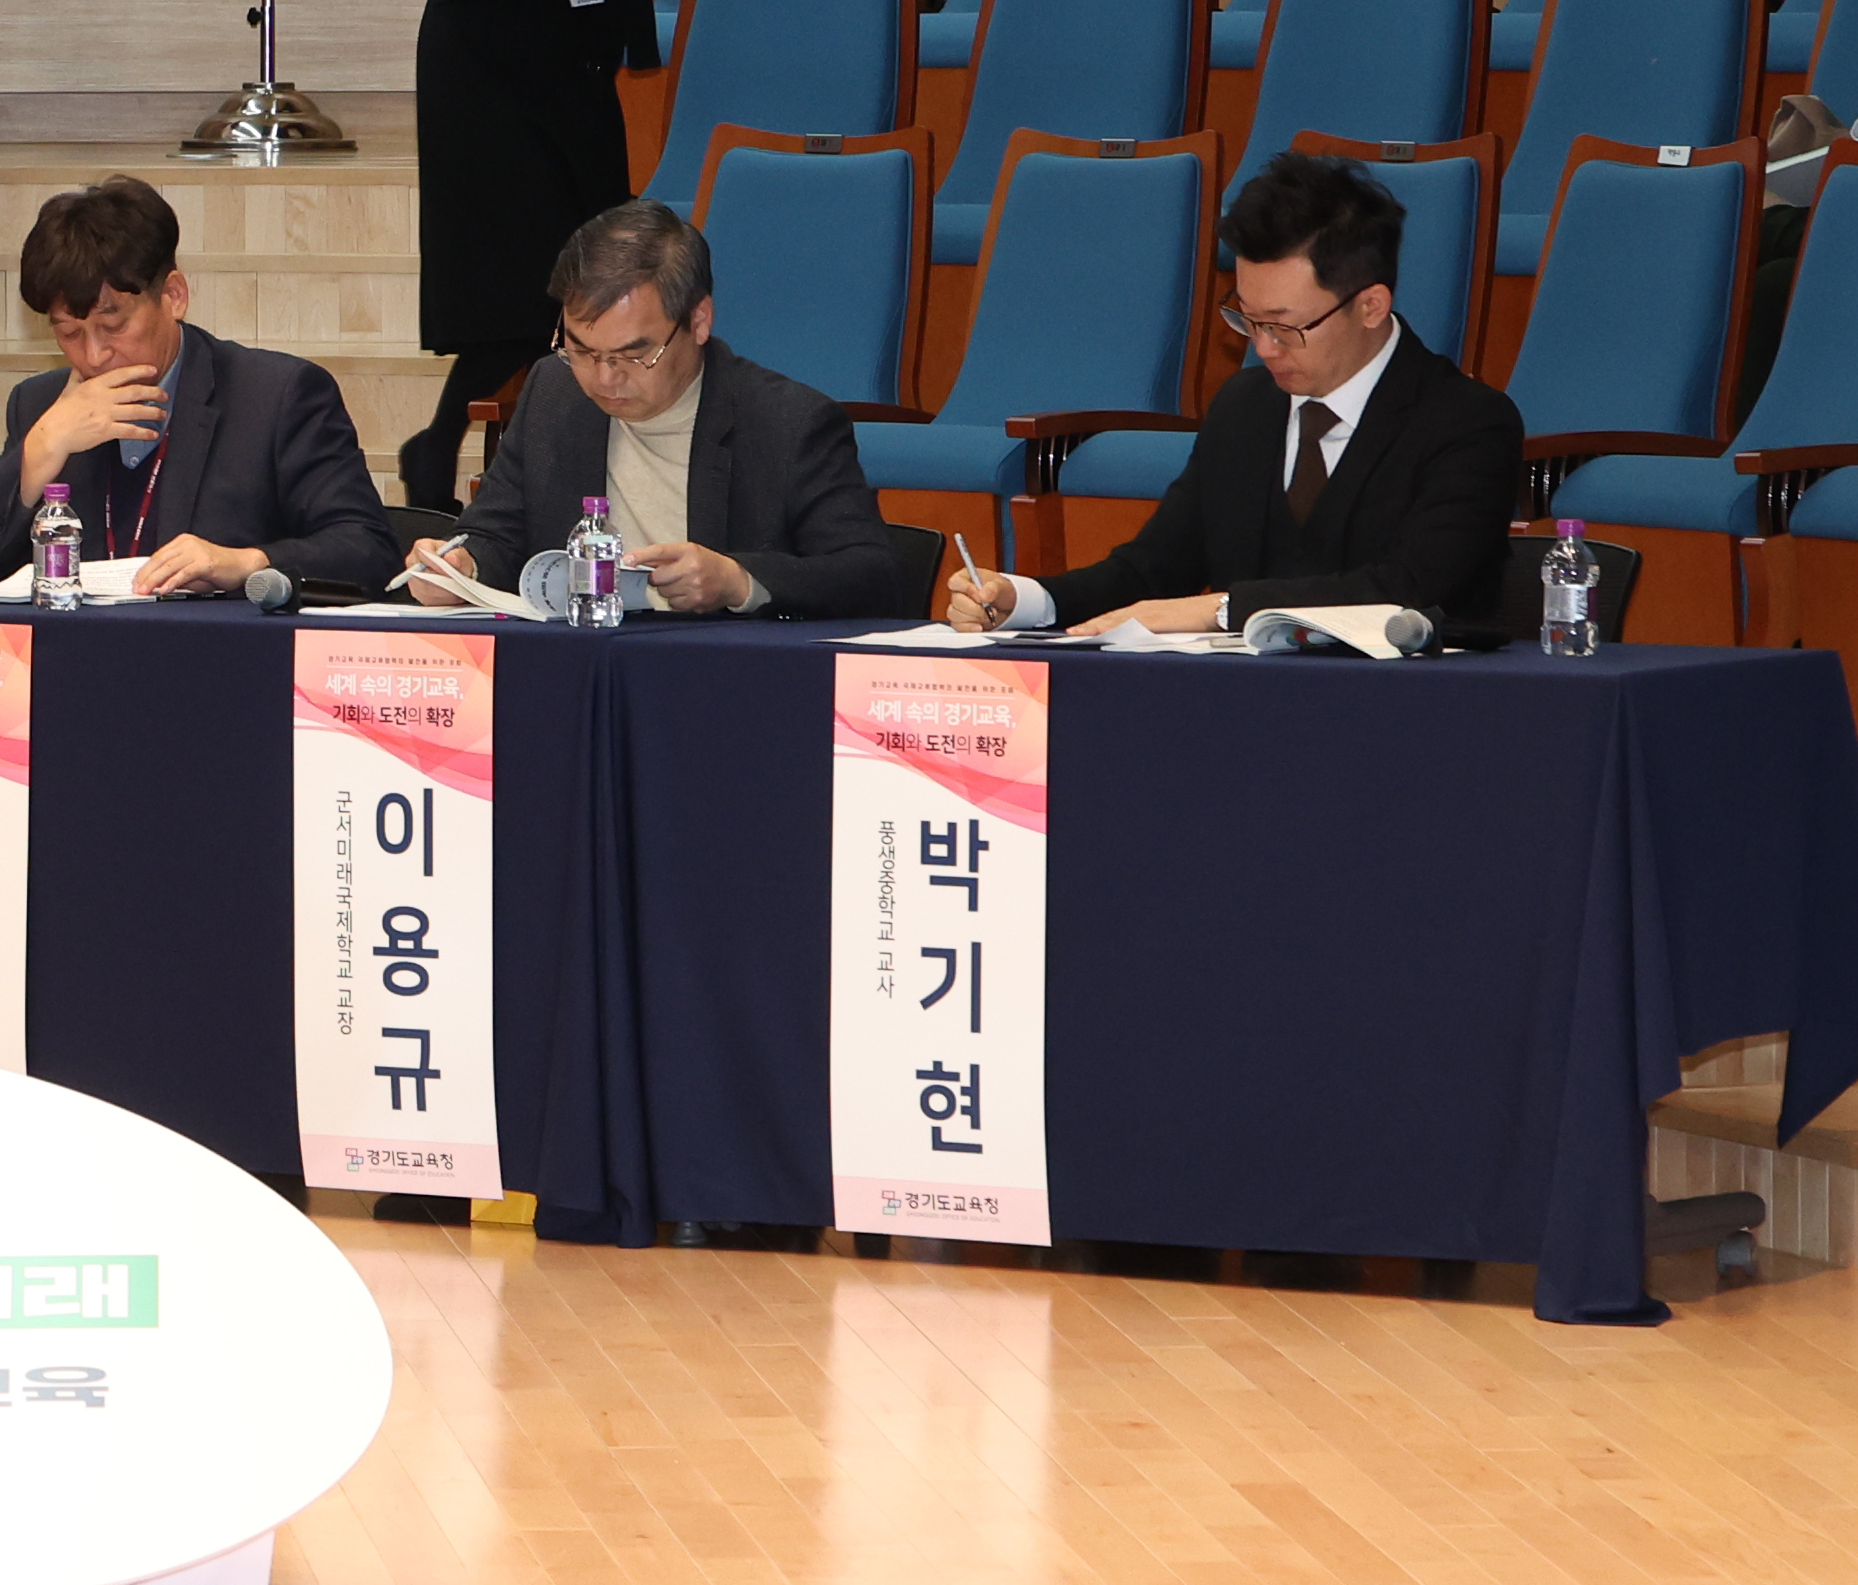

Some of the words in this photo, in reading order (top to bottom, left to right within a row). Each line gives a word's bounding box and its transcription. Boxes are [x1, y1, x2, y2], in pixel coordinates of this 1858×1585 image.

[324, 673, 357, 696] 세계
[360, 674, 392, 697] 속의
[396, 676, 464, 700] 경기교육,
[332, 704, 375, 725] 기회와
[378, 705, 422, 726] 도전의
[425, 706, 456, 728] 확장
[866, 699, 902, 723] 세계
[905, 700, 940, 725] 속의
[943, 702, 1017, 729] 경기교육,
[875, 731, 922, 753] 기회와
[925, 734, 971, 755] 도전의
[975, 735, 1008, 758] 확장
[335, 790, 354, 979] 군서미래국제학교
[876, 820, 897, 942] 풍생중학교
[372, 787, 441, 1112] 이용규
[876, 951, 895, 999] 교사
[915, 818, 990, 1155] 박기현
[336, 988, 354, 1036] 교장
[366, 1149, 454, 1171] 경기도교육청
[905, 1192, 999, 1216] 경기도교육청
